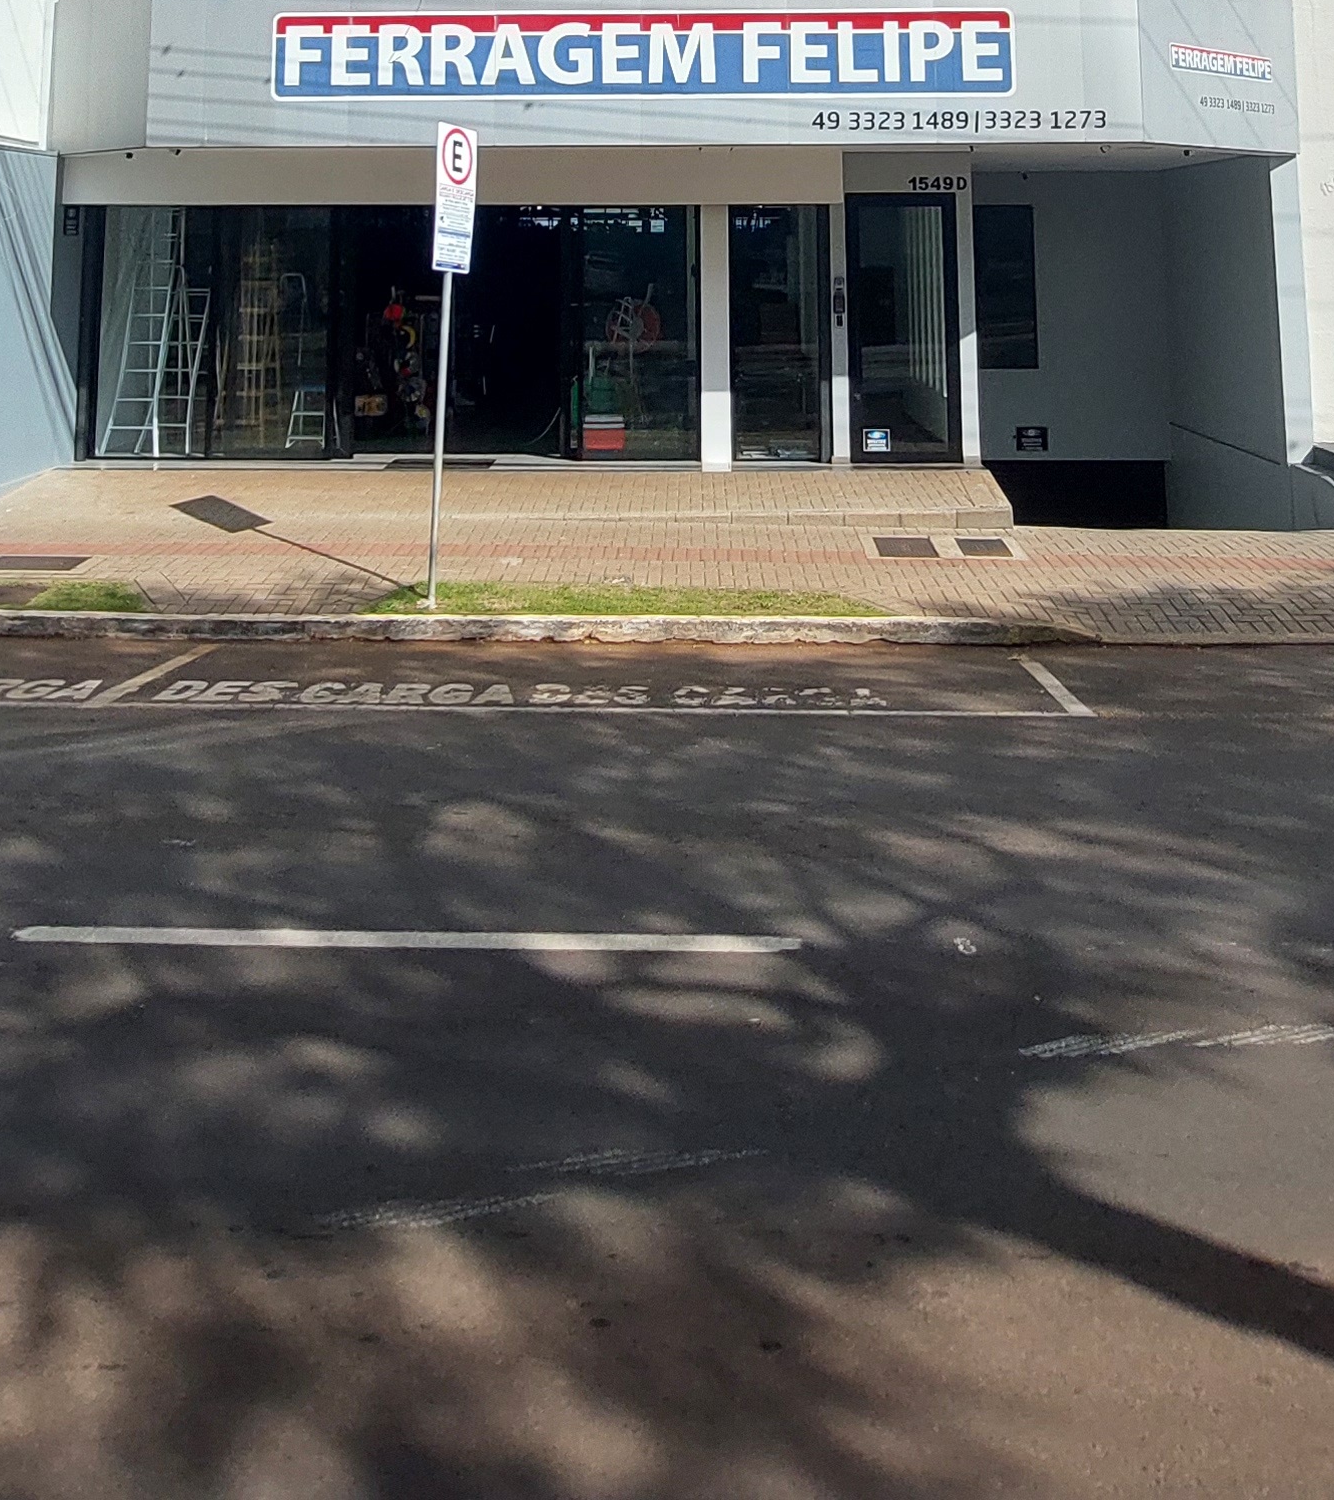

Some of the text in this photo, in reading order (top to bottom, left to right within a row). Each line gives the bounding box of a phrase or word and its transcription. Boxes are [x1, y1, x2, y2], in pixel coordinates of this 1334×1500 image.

[282, 19, 1004, 87] FERRAGEM FELIPE
[1170, 45, 1272, 79] FERRAGEM FELIPE
[811, 110, 841, 131] 49
[847, 110, 906, 131] 3323
[1049, 110, 1107, 130] 1273
[452, 140, 463, 173] E
